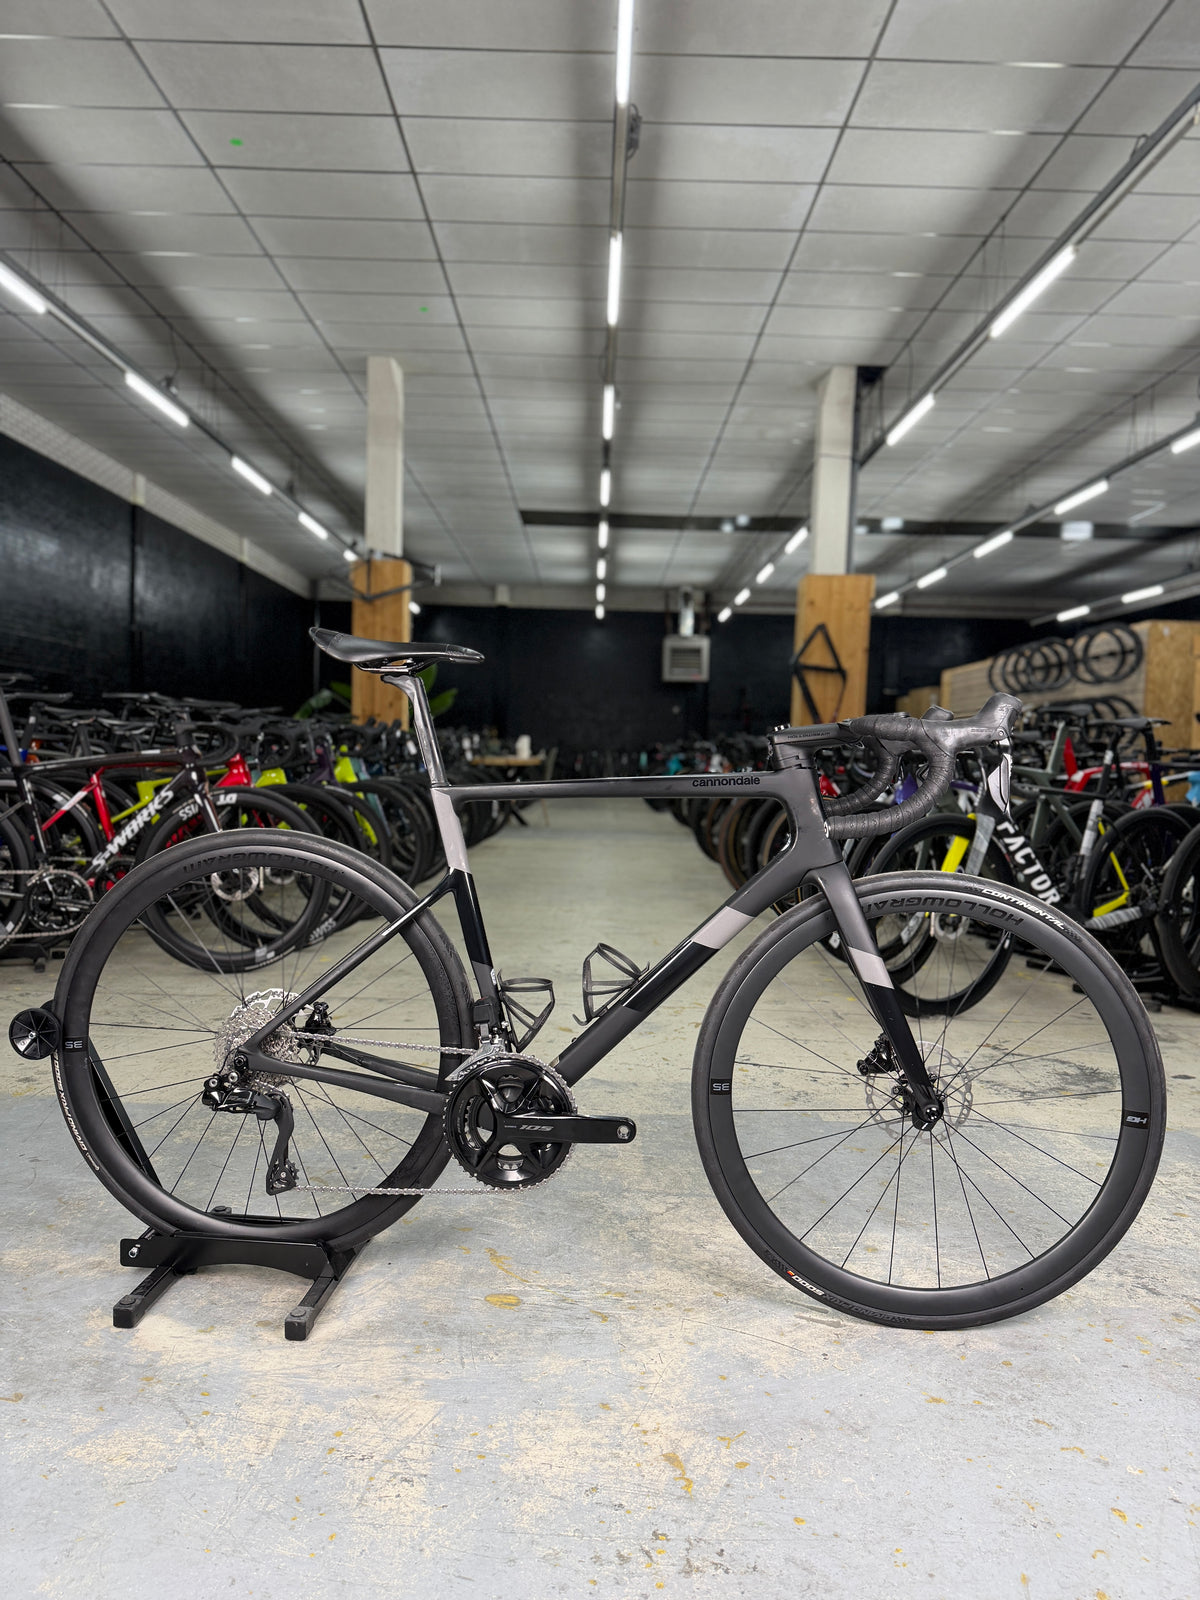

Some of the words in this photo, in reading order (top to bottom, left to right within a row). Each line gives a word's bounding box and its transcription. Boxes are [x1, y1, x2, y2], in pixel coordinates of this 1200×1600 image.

[692, 776, 761, 787] cannondale
[216, 793, 238, 806] DT
[92, 790, 174, 873] S-WORKS
[996, 821, 1061, 906] FACTOR
[982, 888, 1064, 930] CONTINENTAL
[65, 1041, 83, 1049] 35
[712, 1083, 730, 1091] 35
[520, 1124, 554, 1132] 105
[792, 1275, 825, 1296] 5000
